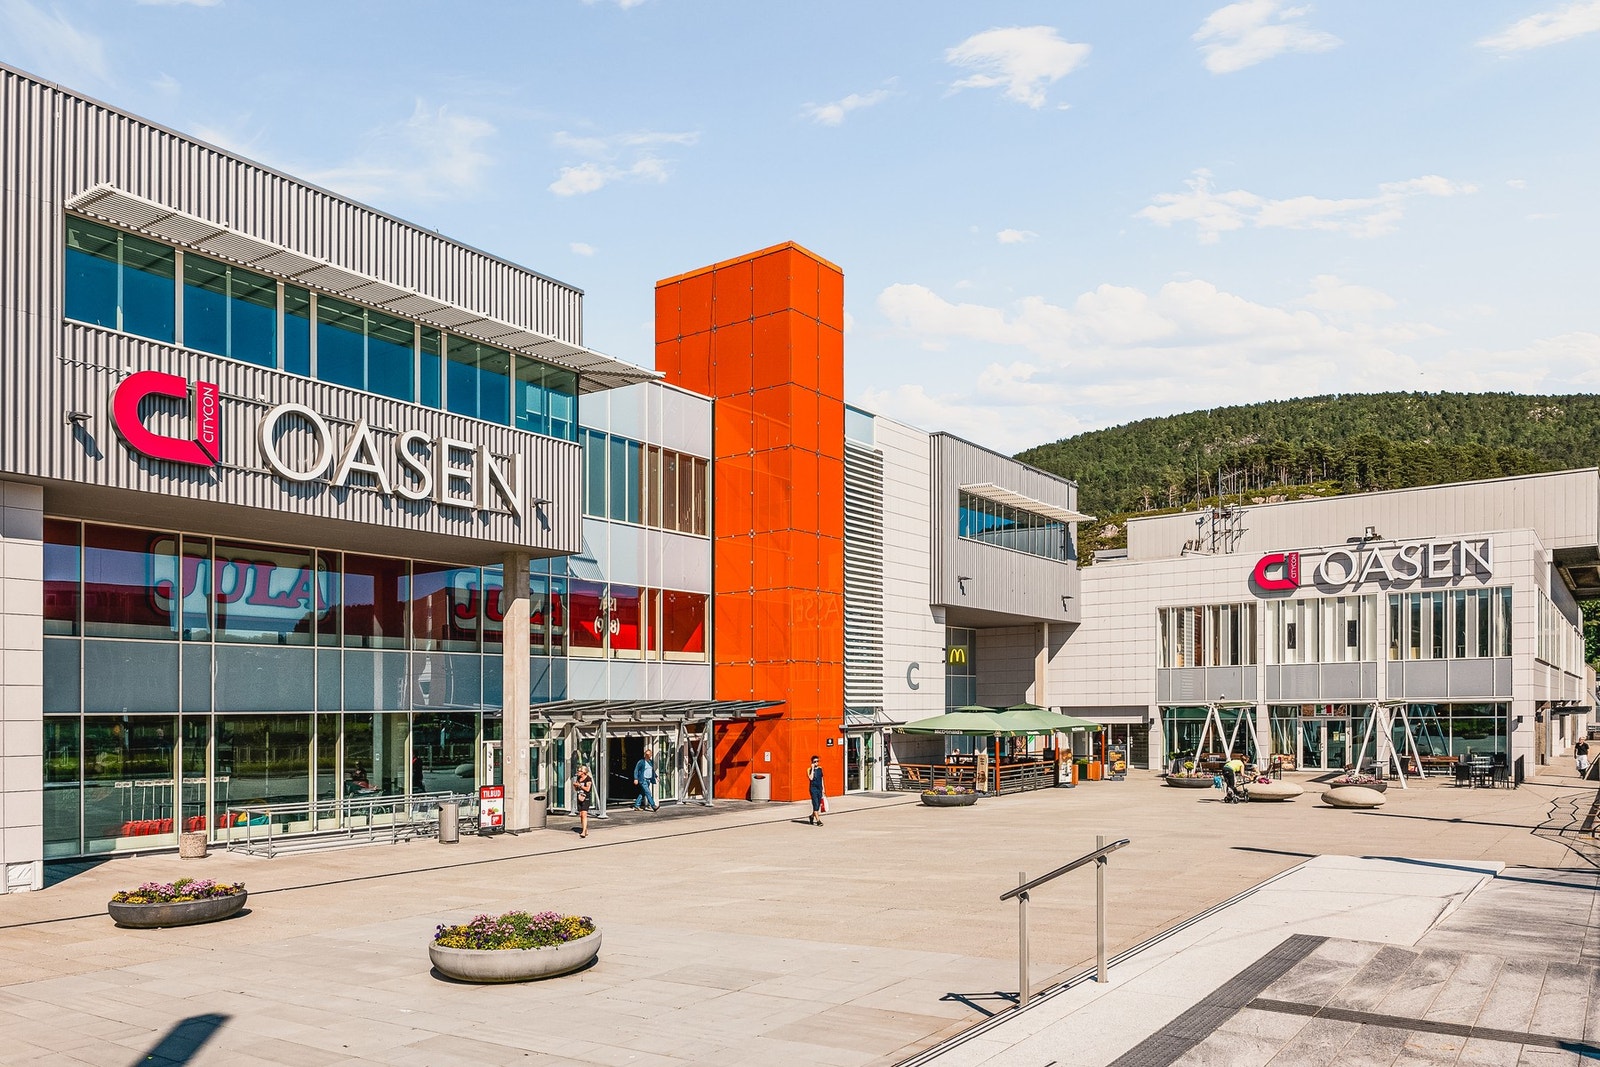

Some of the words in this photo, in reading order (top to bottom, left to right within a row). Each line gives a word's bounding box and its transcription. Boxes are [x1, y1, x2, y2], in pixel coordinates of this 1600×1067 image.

[203, 387, 214, 443] CITYCON
[259, 403, 522, 521] OASEN
[154, 552, 327, 610] JULA
[1319, 538, 1493, 586] OASEN
[907, 662, 919, 690] C
[483, 789, 502, 798] TILBUD
